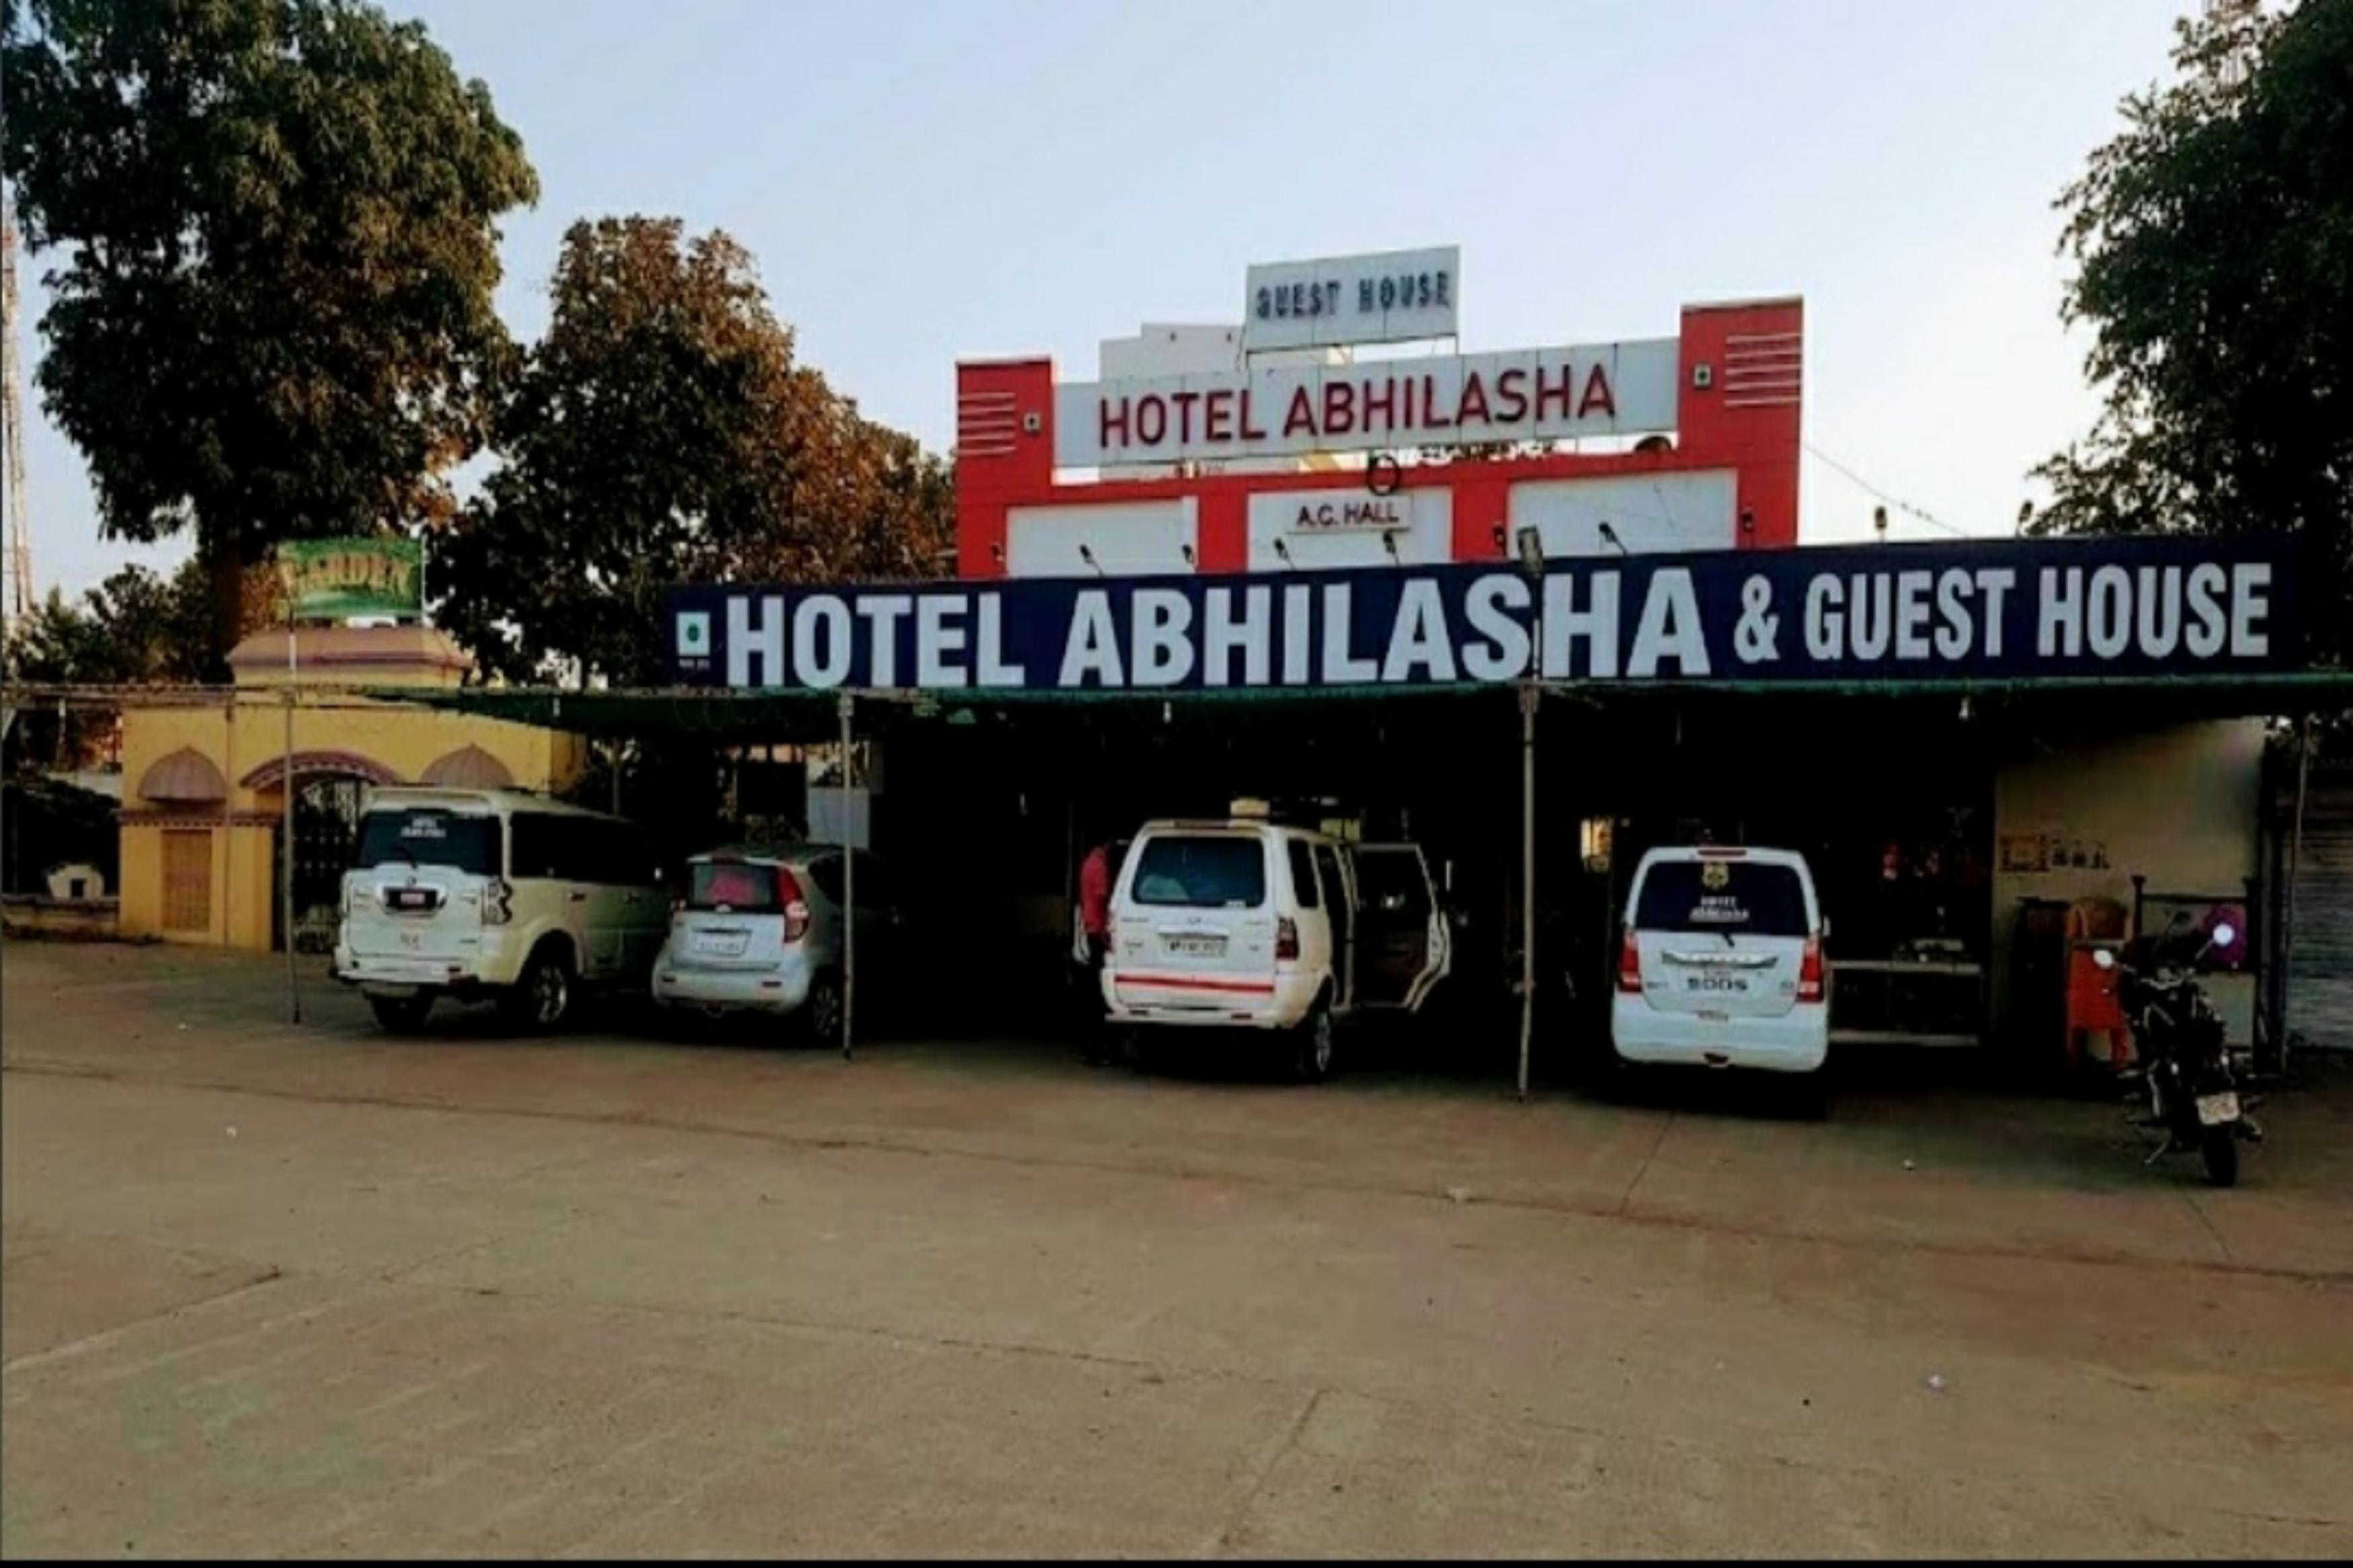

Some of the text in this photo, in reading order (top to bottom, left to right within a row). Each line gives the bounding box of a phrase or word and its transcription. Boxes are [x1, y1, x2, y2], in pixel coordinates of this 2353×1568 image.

[1257, 270, 1449, 319] GUEST HOUSE
[1099, 363, 1616, 449] HOTEL ABHILASHA
[1344, 501, 1400, 526] HALL
[727, 562, 2272, 690] HOTEL ABHILASHA & GUEST HOUSE
